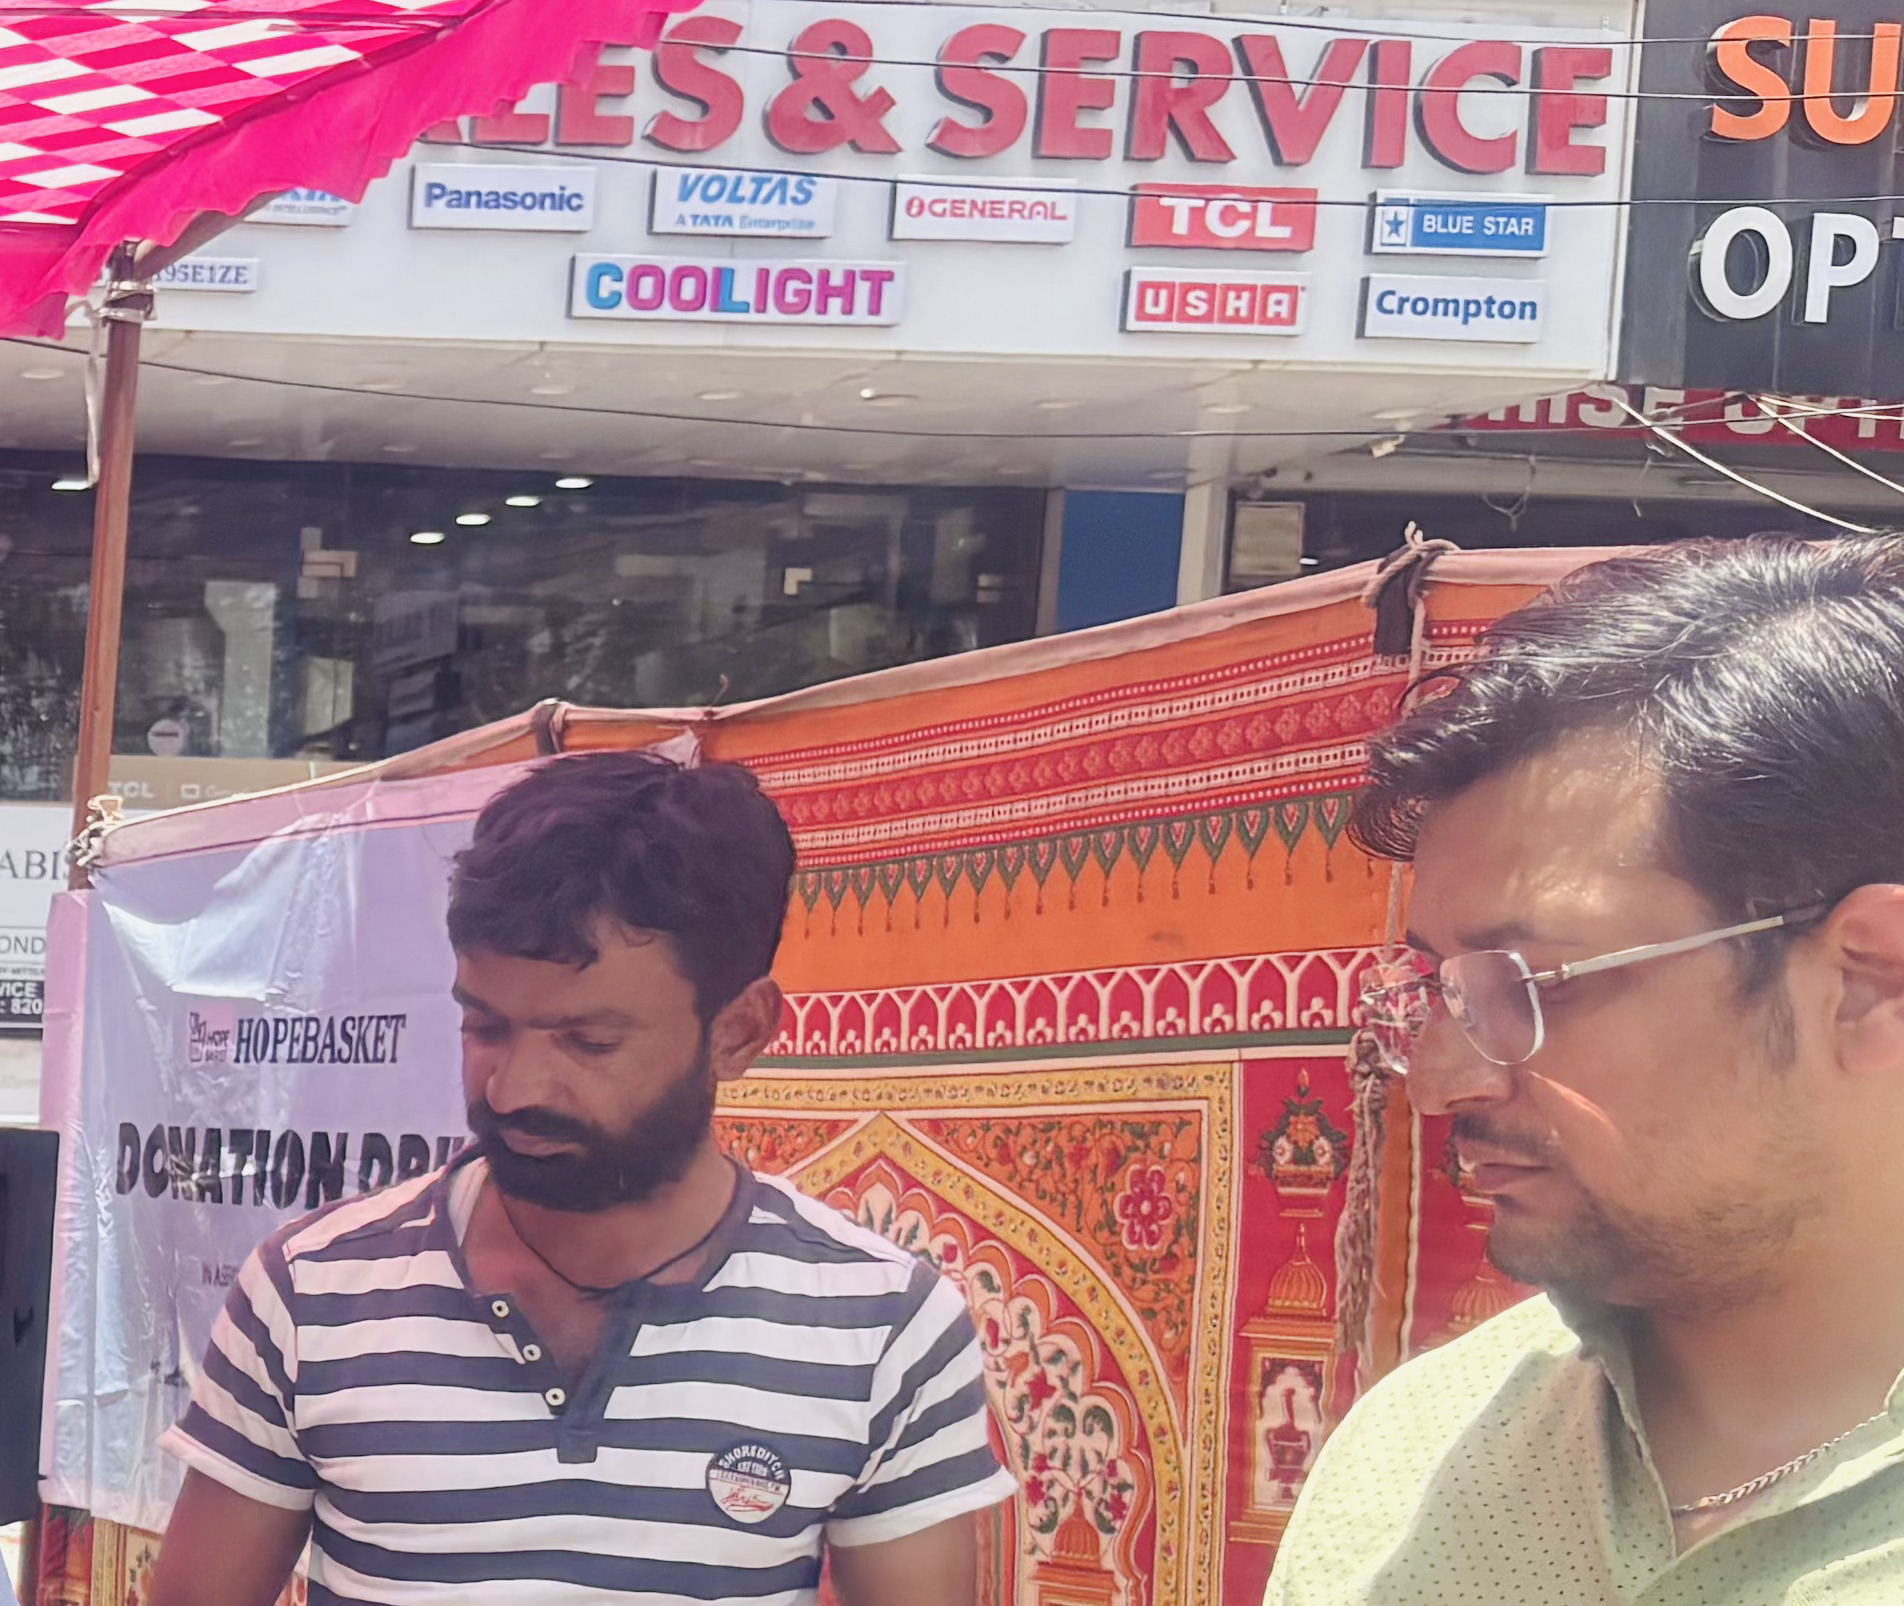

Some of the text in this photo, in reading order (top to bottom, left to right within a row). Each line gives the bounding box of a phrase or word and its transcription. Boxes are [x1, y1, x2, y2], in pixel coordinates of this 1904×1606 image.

[765, 20, 902, 154] &
[925, 23, 1612, 176] SERVICE
[1711, 15, 1902, 145] SU
[424, 182, 584, 214] Panasonic
[677, 174, 818, 206] VOLTAS
[927, 197, 1068, 222] GENERAL
[690, 214, 734, 228] TATA
[1159, 194, 1293, 239] TCL
[1422, 213, 1534, 236] BLUE STAR
[1699, 206, 1904, 324] OP
[585, 262, 895, 316] COOLIGHT
[1144, 287, 1290, 320] USHA
[1375, 289, 1538, 326] Crompton
[233, 1013, 407, 1065] HOPEBASKET
[115, 1121, 349, 1210] DONATION
